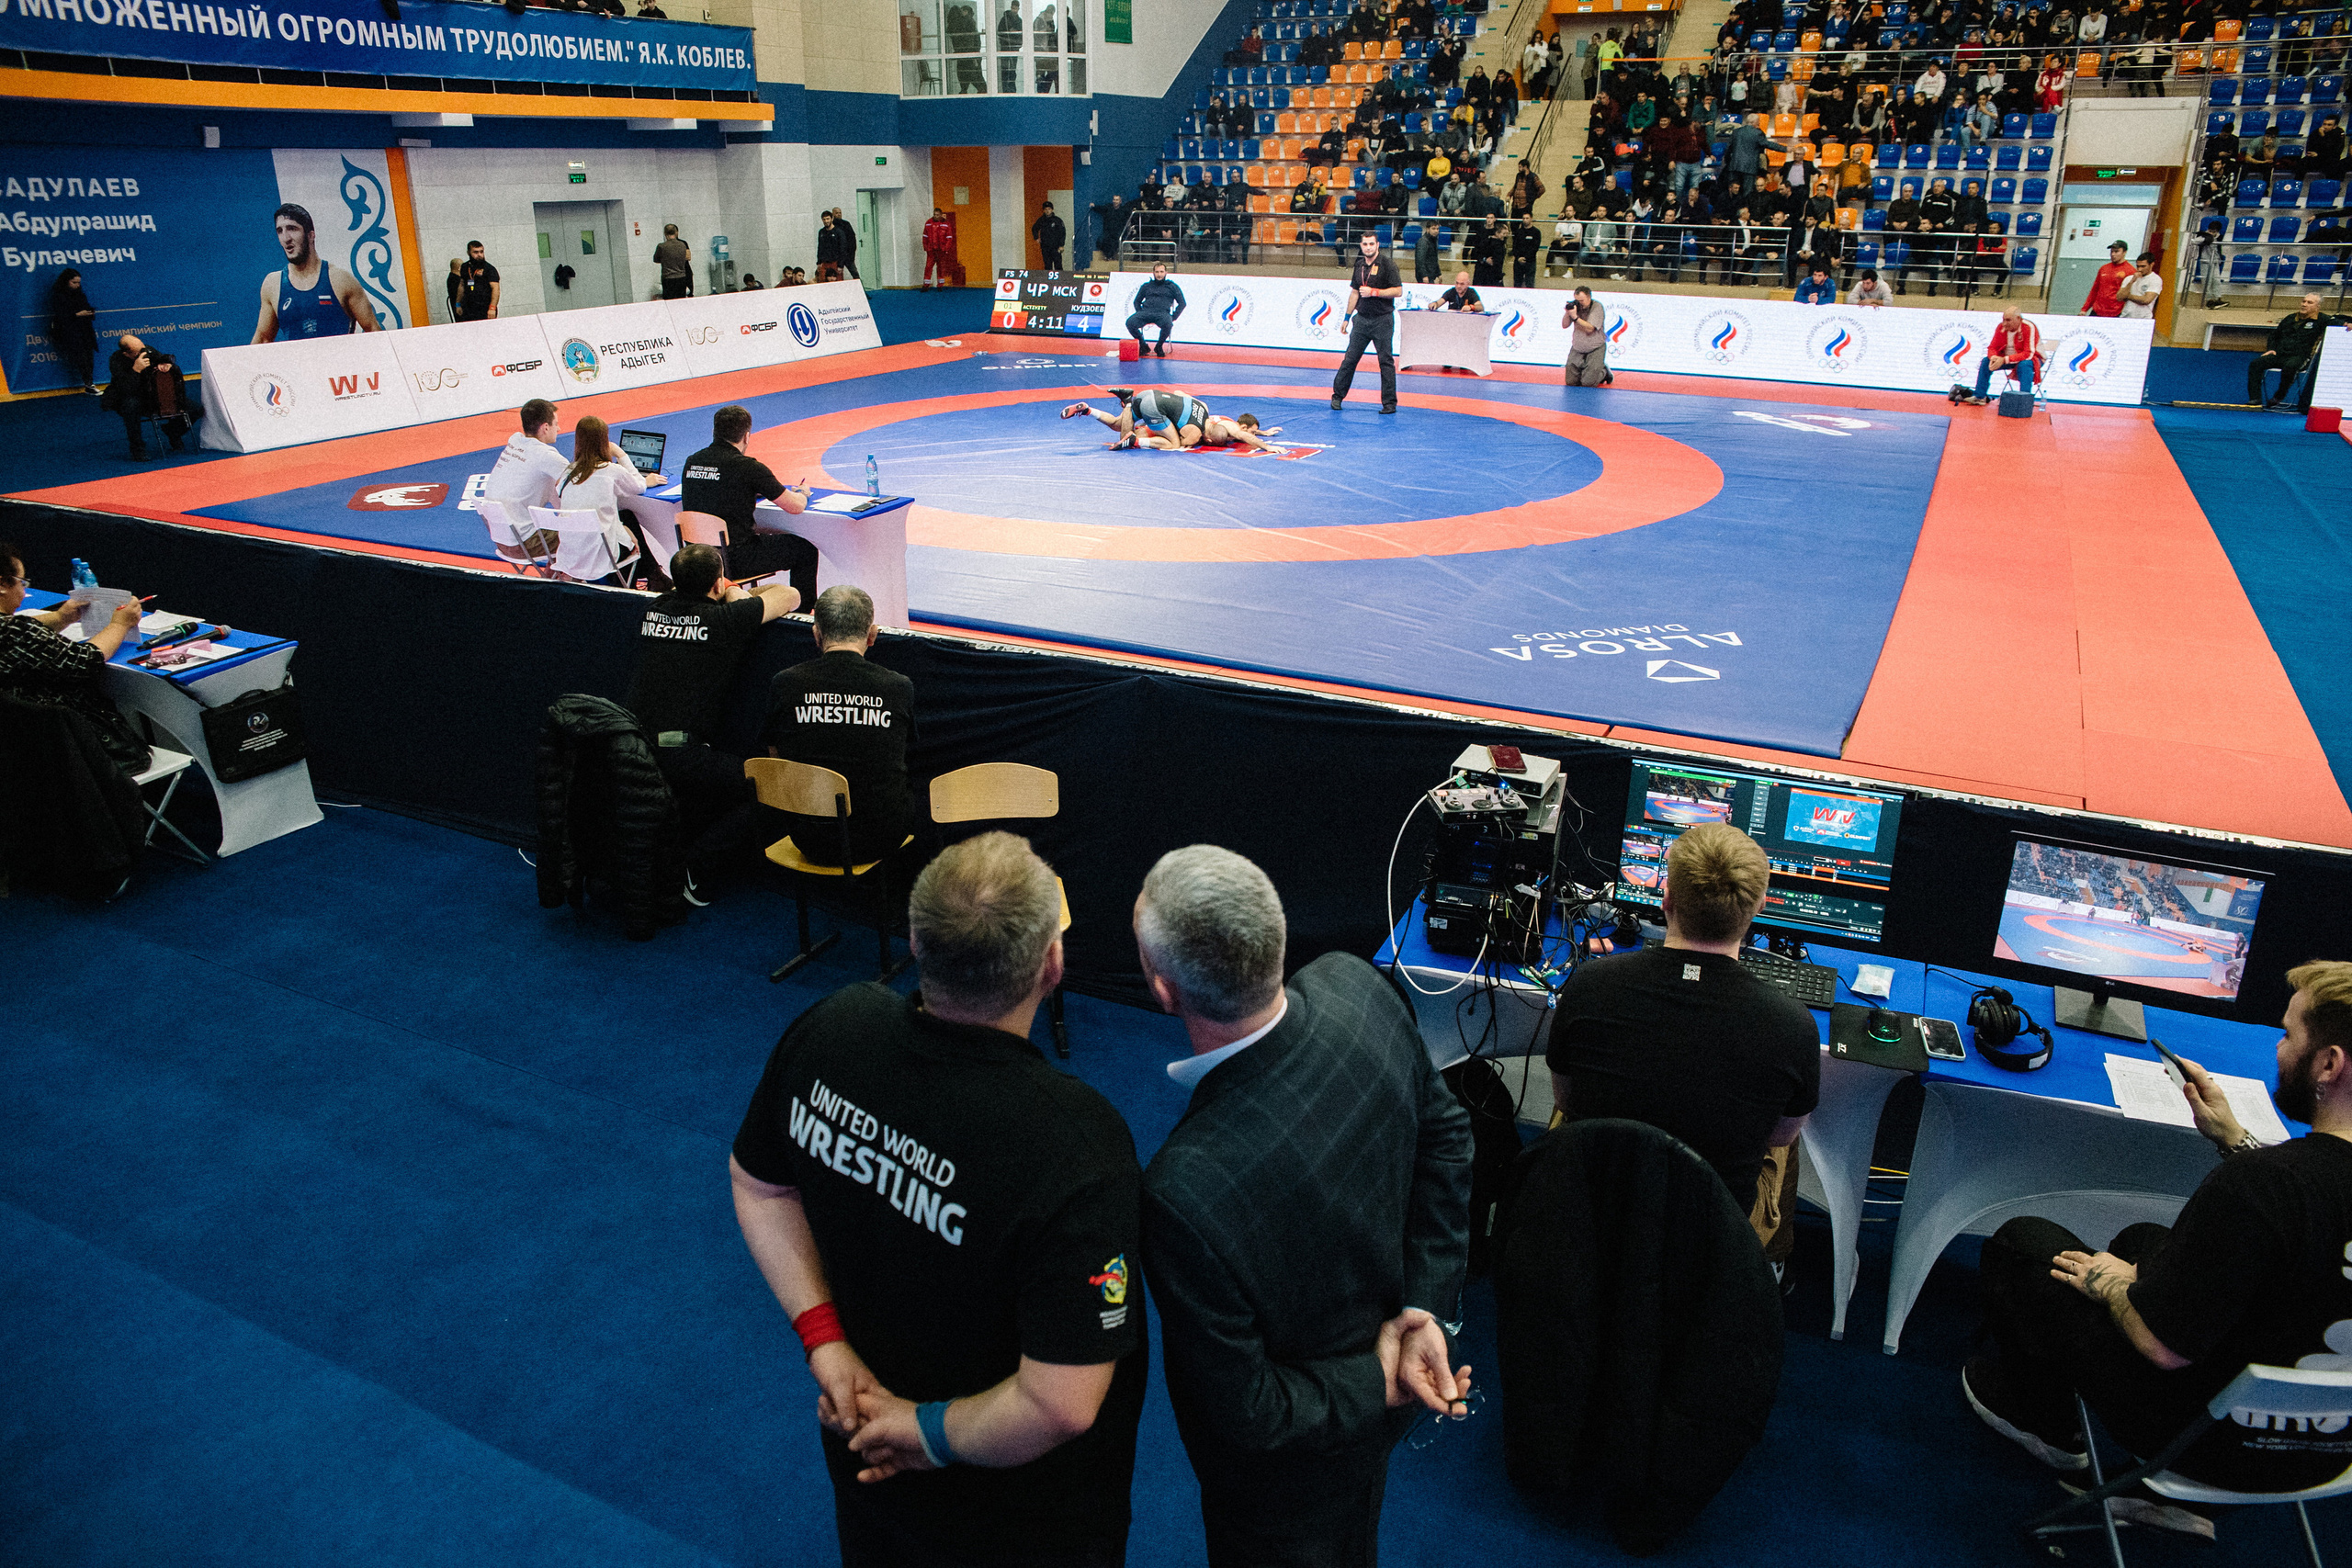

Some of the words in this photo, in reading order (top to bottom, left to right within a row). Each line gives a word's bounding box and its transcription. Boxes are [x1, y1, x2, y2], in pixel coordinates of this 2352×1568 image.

[277, 13, 447, 51] ОГРОМНЫМ
[639, 44, 675, 66] Я.К.
[678, 45, 752, 70] КОБЛЕВ.
[0, 212, 156, 236] Абдулрашид
[3, 246, 136, 272] Булачевич
[1019, 270, 1029, 278] 74
[1048, 271, 1059, 280] 95
[1052, 285, 1078, 298] МСК
[818, 305, 851, 316] Адыгейский
[1070, 304, 1105, 313] КУДЗОЕВ
[820, 312, 870, 325] Государственный
[1002, 311, 1016, 329] 0
[1027, 315, 1064, 330] 4:11
[1077, 315, 1090, 333] 4
[179, 320, 223, 333] чемпион
[751, 321, 777, 333] ФСБР
[824, 324, 858, 335] Университет
[600, 336, 673, 356] РЕСПУБЛИКА
[29, 352, 59, 364] 2016
[620, 352, 666, 369] АДЫГЕЯ
[506, 359, 543, 373] ФСБР
[686, 470, 720, 480] WRESTLING
[646, 611, 670, 625] UNITED
[671, 615, 700, 626] WORLD
[641, 621, 708, 641] WRESTLING
[1511, 624, 1690, 643] DIAMONDS
[1488, 631, 1744, 661] ALROSA
[804, 693, 842, 705] UNITED
[843, 694, 883, 707] WORLD
[795, 706, 891, 728] WRESTLING
[810, 1078, 878, 1142] UNITED
[883, 1124, 956, 1188] WORLD
[788, 1097, 967, 1246] WRESTLING
